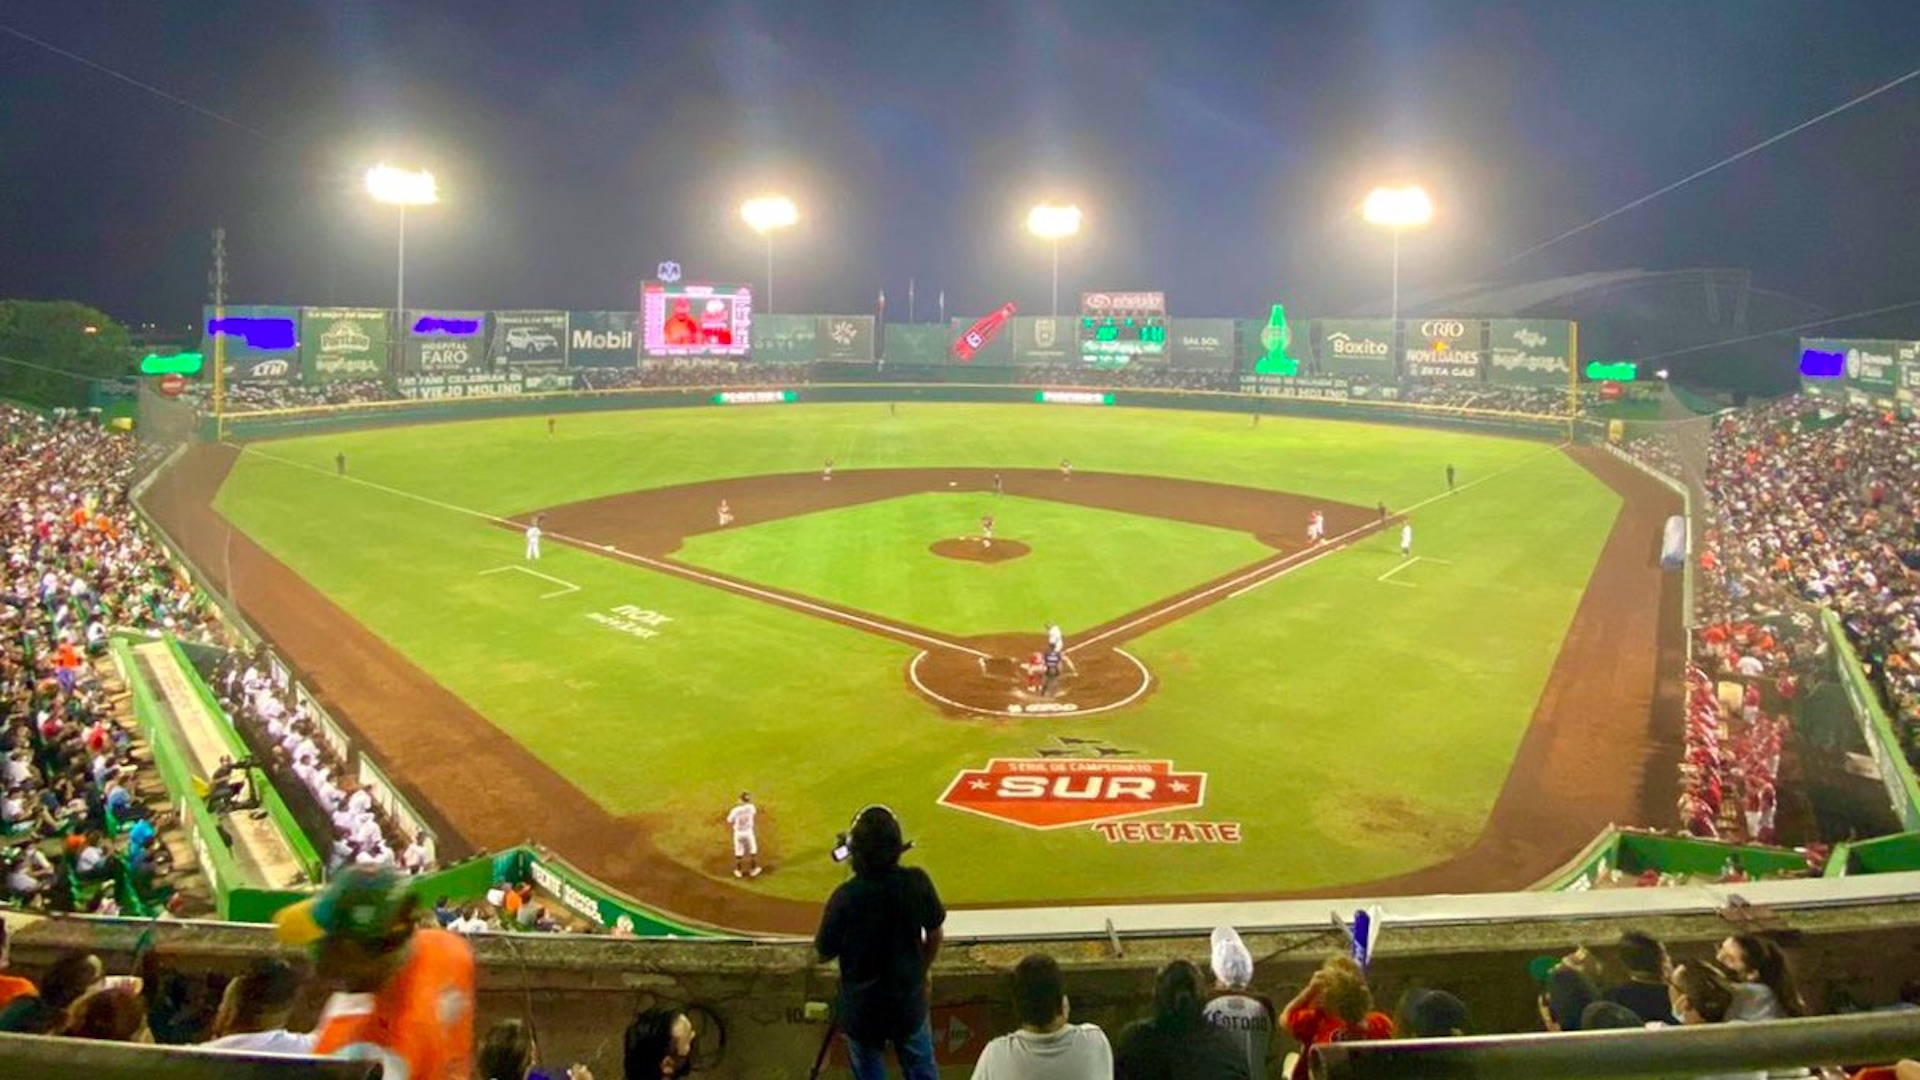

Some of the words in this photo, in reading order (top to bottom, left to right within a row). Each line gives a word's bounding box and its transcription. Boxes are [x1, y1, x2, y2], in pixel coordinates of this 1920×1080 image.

[573, 330, 632, 349] Mobil
[1334, 339, 1388, 354] Boxito
[421, 350, 467, 364] FARO
[1406, 350, 1479, 364] NOVEDADES
[1451, 367, 1476, 377] GAS
[420, 385, 463, 398] VIEJO
[467, 383, 522, 396] MOLINO
[1298, 388, 1348, 399] MOLINO
[1008, 763, 1048, 772] SERIE
[1049, 763, 1067, 772] DE
[1069, 763, 1153, 772] CAMPEONATO
[996, 775, 1157, 799] SUR
[1092, 821, 1242, 844] TECATE
[1204, 1010, 1269, 1031] Corona
